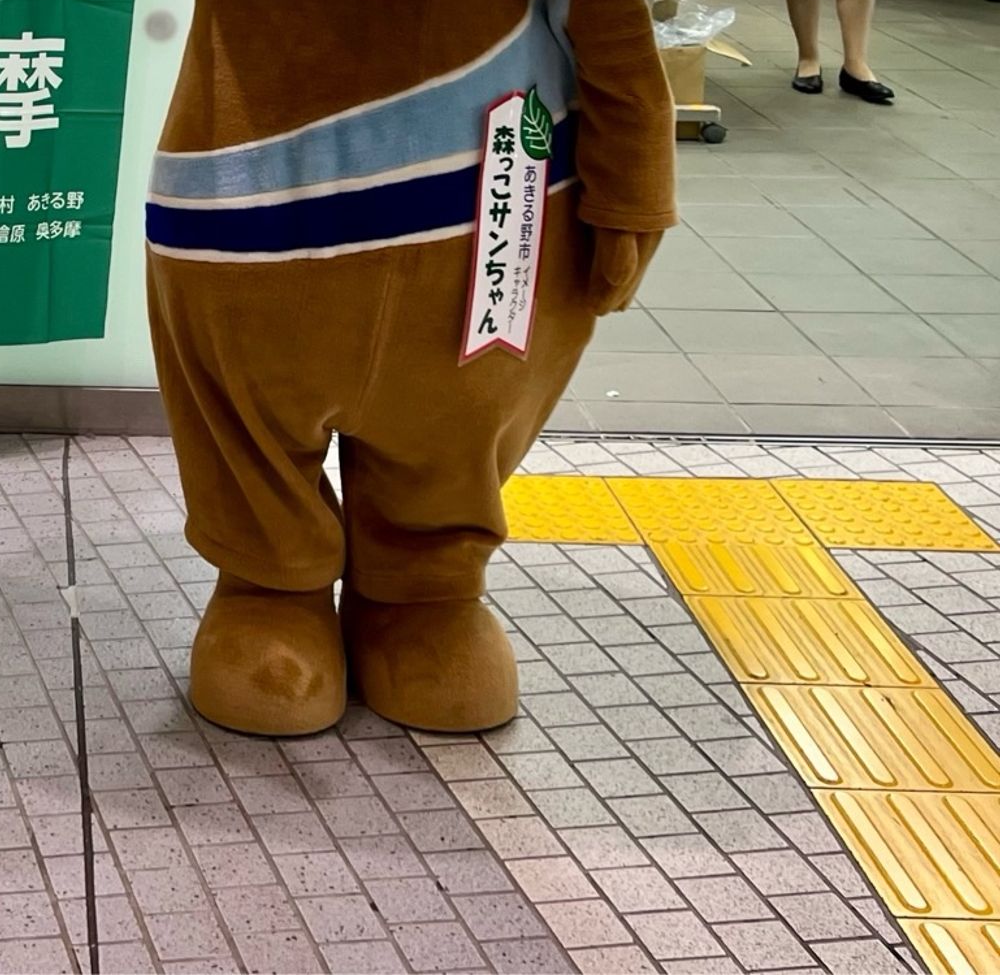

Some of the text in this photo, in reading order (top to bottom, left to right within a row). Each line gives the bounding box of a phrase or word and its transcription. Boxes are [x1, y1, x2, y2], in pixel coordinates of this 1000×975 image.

[27, 190, 85, 212] あきる野
[477, 125, 516, 335] 森っこサンちゃん
[518, 165, 537, 260] あきる野市
[35, 220, 82, 241] 奥多摩
